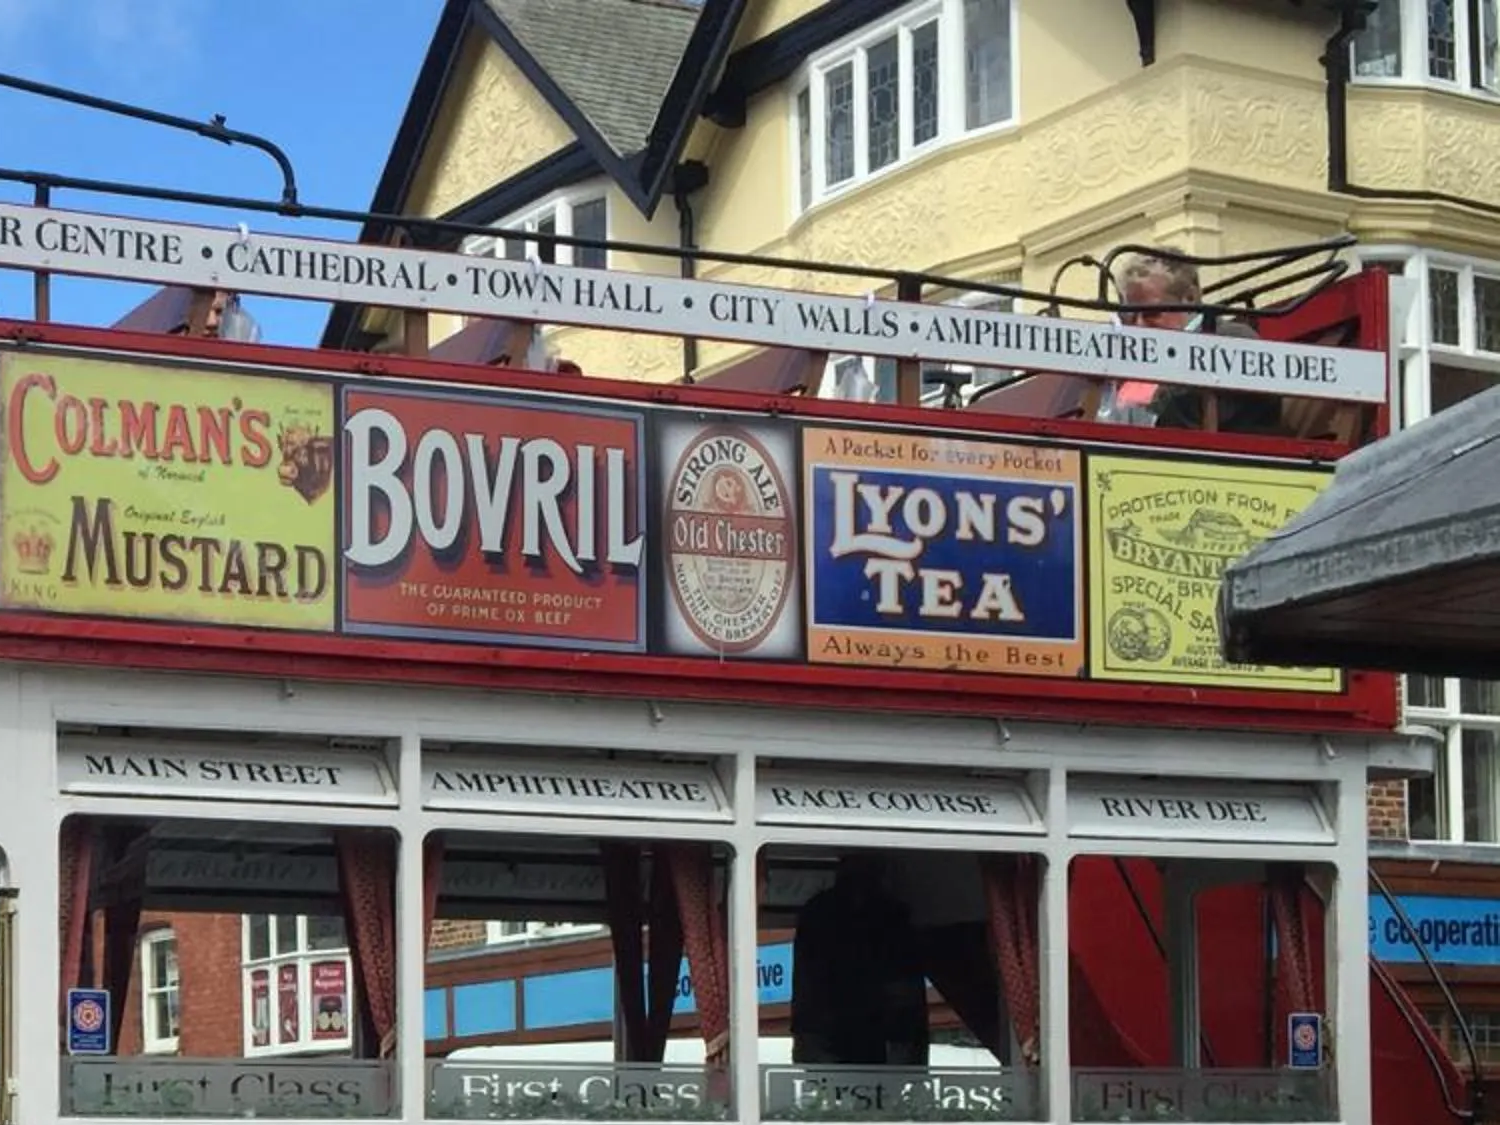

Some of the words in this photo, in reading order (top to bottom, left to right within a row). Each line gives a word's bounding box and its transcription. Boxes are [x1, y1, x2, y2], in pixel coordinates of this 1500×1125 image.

[36, 218, 184, 265] CENTRE
[226, 239, 438, 292] CATHEDRAL
[466, 266, 564, 301] TOWN
[575, 280, 663, 314] HALL
[710, 294, 780, 325] CITY
[798, 302, 899, 338] WALLS
[925, 316, 1159, 364] AMPHITHEATRE
[1189, 345, 1275, 379] RIVER
[1284, 354, 1338, 383] DEE
[8, 373, 273, 486] COLMAN'S
[826, 438, 836, 454] A
[843, 439, 903, 460] Packet
[1003, 451, 1061, 472] Pocket
[343, 408, 645, 573] BOVRIL
[678, 439, 747, 507] STRONG
[749, 463, 779, 511] ALE
[124, 505, 175, 524] Original
[180, 509, 226, 528] English
[829, 472, 1066, 560] LYONS'
[1107, 489, 1218, 521] PROTECTION
[1226, 492, 1276, 517] FROM
[61, 496, 328, 600] MUSTARD
[674, 516, 709, 549] Old
[715, 519, 785, 555] Chester
[1115, 540, 1222, 578] BRYANT
[401, 583, 428, 598] THE
[433, 586, 526, 604] GUARANTEED
[533, 592, 602, 609] PRODUCT
[865, 558, 1025, 622] TEA
[1112, 576, 1183, 621] SPECIAL
[427, 604, 445, 616] OF
[453, 605, 499, 621] PRIME
[506, 609, 526, 621] OX
[535, 610, 572, 625] BEEF
[822, 635, 925, 665] Always
[945, 644, 989, 663] the
[1006, 647, 1065, 667] Best
[85, 755, 187, 778] MAIN
[200, 759, 341, 786] STREET
[432, 771, 706, 803] AMPHITHEATRE
[771, 787, 861, 809] RACE
[868, 790, 997, 815] COURSE
[1100, 798, 1201, 820] RIVER
[1206, 800, 1267, 823] DEE
[103, 1073, 211, 1107] First
[230, 1072, 362, 1107] Class
[461, 1073, 562, 1106] First
[578, 1073, 700, 1108] Class
[792, 1077, 887, 1110] First
[901, 1077, 1013, 1111] Class
[1102, 1081, 1183, 1112] First
